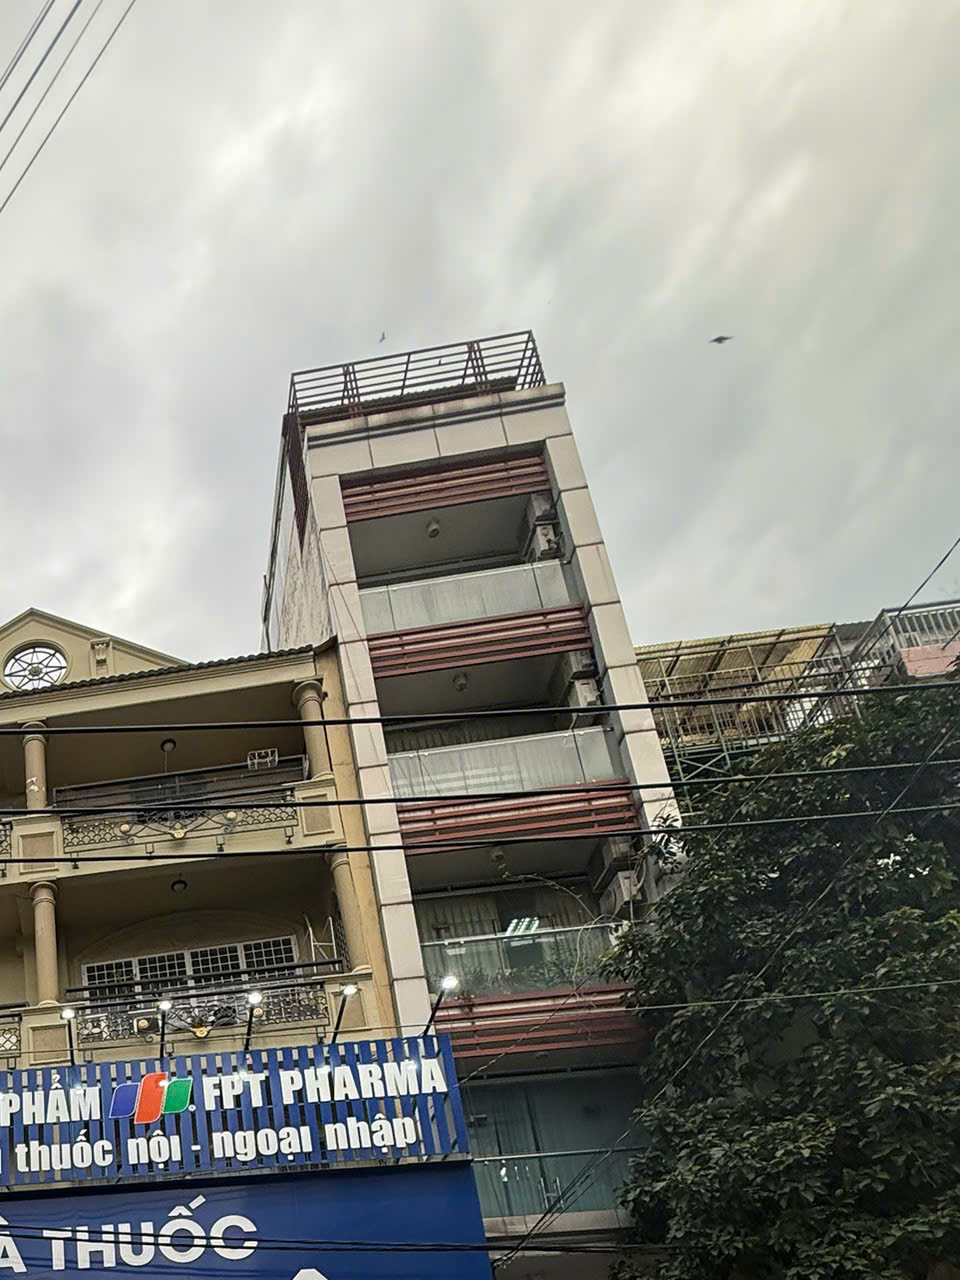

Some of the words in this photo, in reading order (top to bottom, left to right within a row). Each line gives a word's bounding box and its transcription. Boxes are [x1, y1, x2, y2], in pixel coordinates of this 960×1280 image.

[203, 1073, 267, 1111] FPT
[280, 1058, 449, 1105] PHARMA
[15, 1128, 113, 1173] thuốc
[127, 1130, 181, 1169] nội
[213, 1125, 313, 1162] ngoại
[325, 1113, 417, 1153] nhập
[43, 1194, 259, 1271] THUỐC
